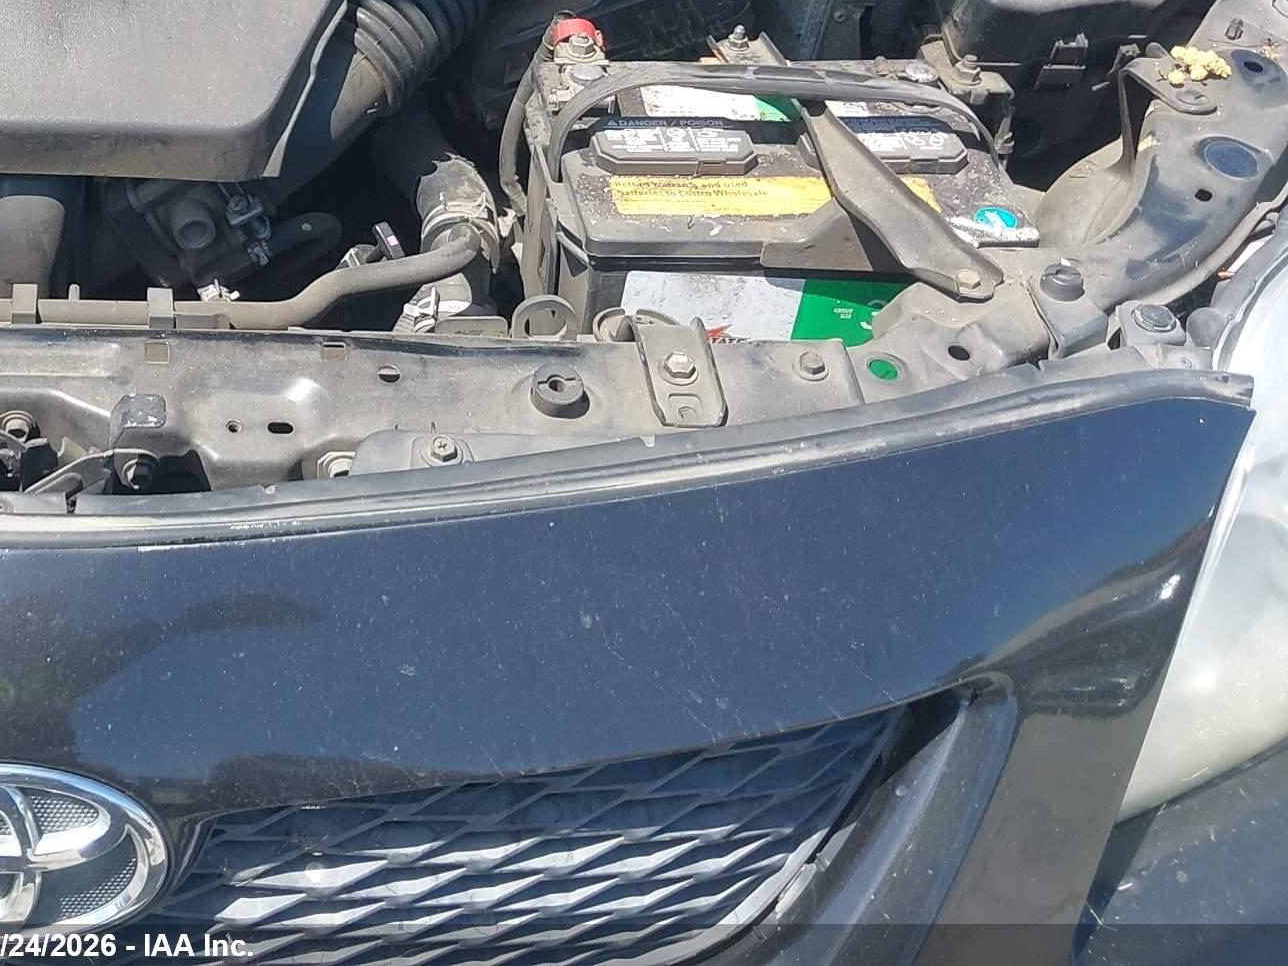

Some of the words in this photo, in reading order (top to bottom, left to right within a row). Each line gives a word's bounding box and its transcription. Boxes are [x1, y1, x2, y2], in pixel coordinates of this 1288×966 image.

[619, 119, 668, 127] DANGER
[679, 119, 724, 127] POISON
[724, 180, 748, 188] used
[713, 189, 769, 197] Wholesale
